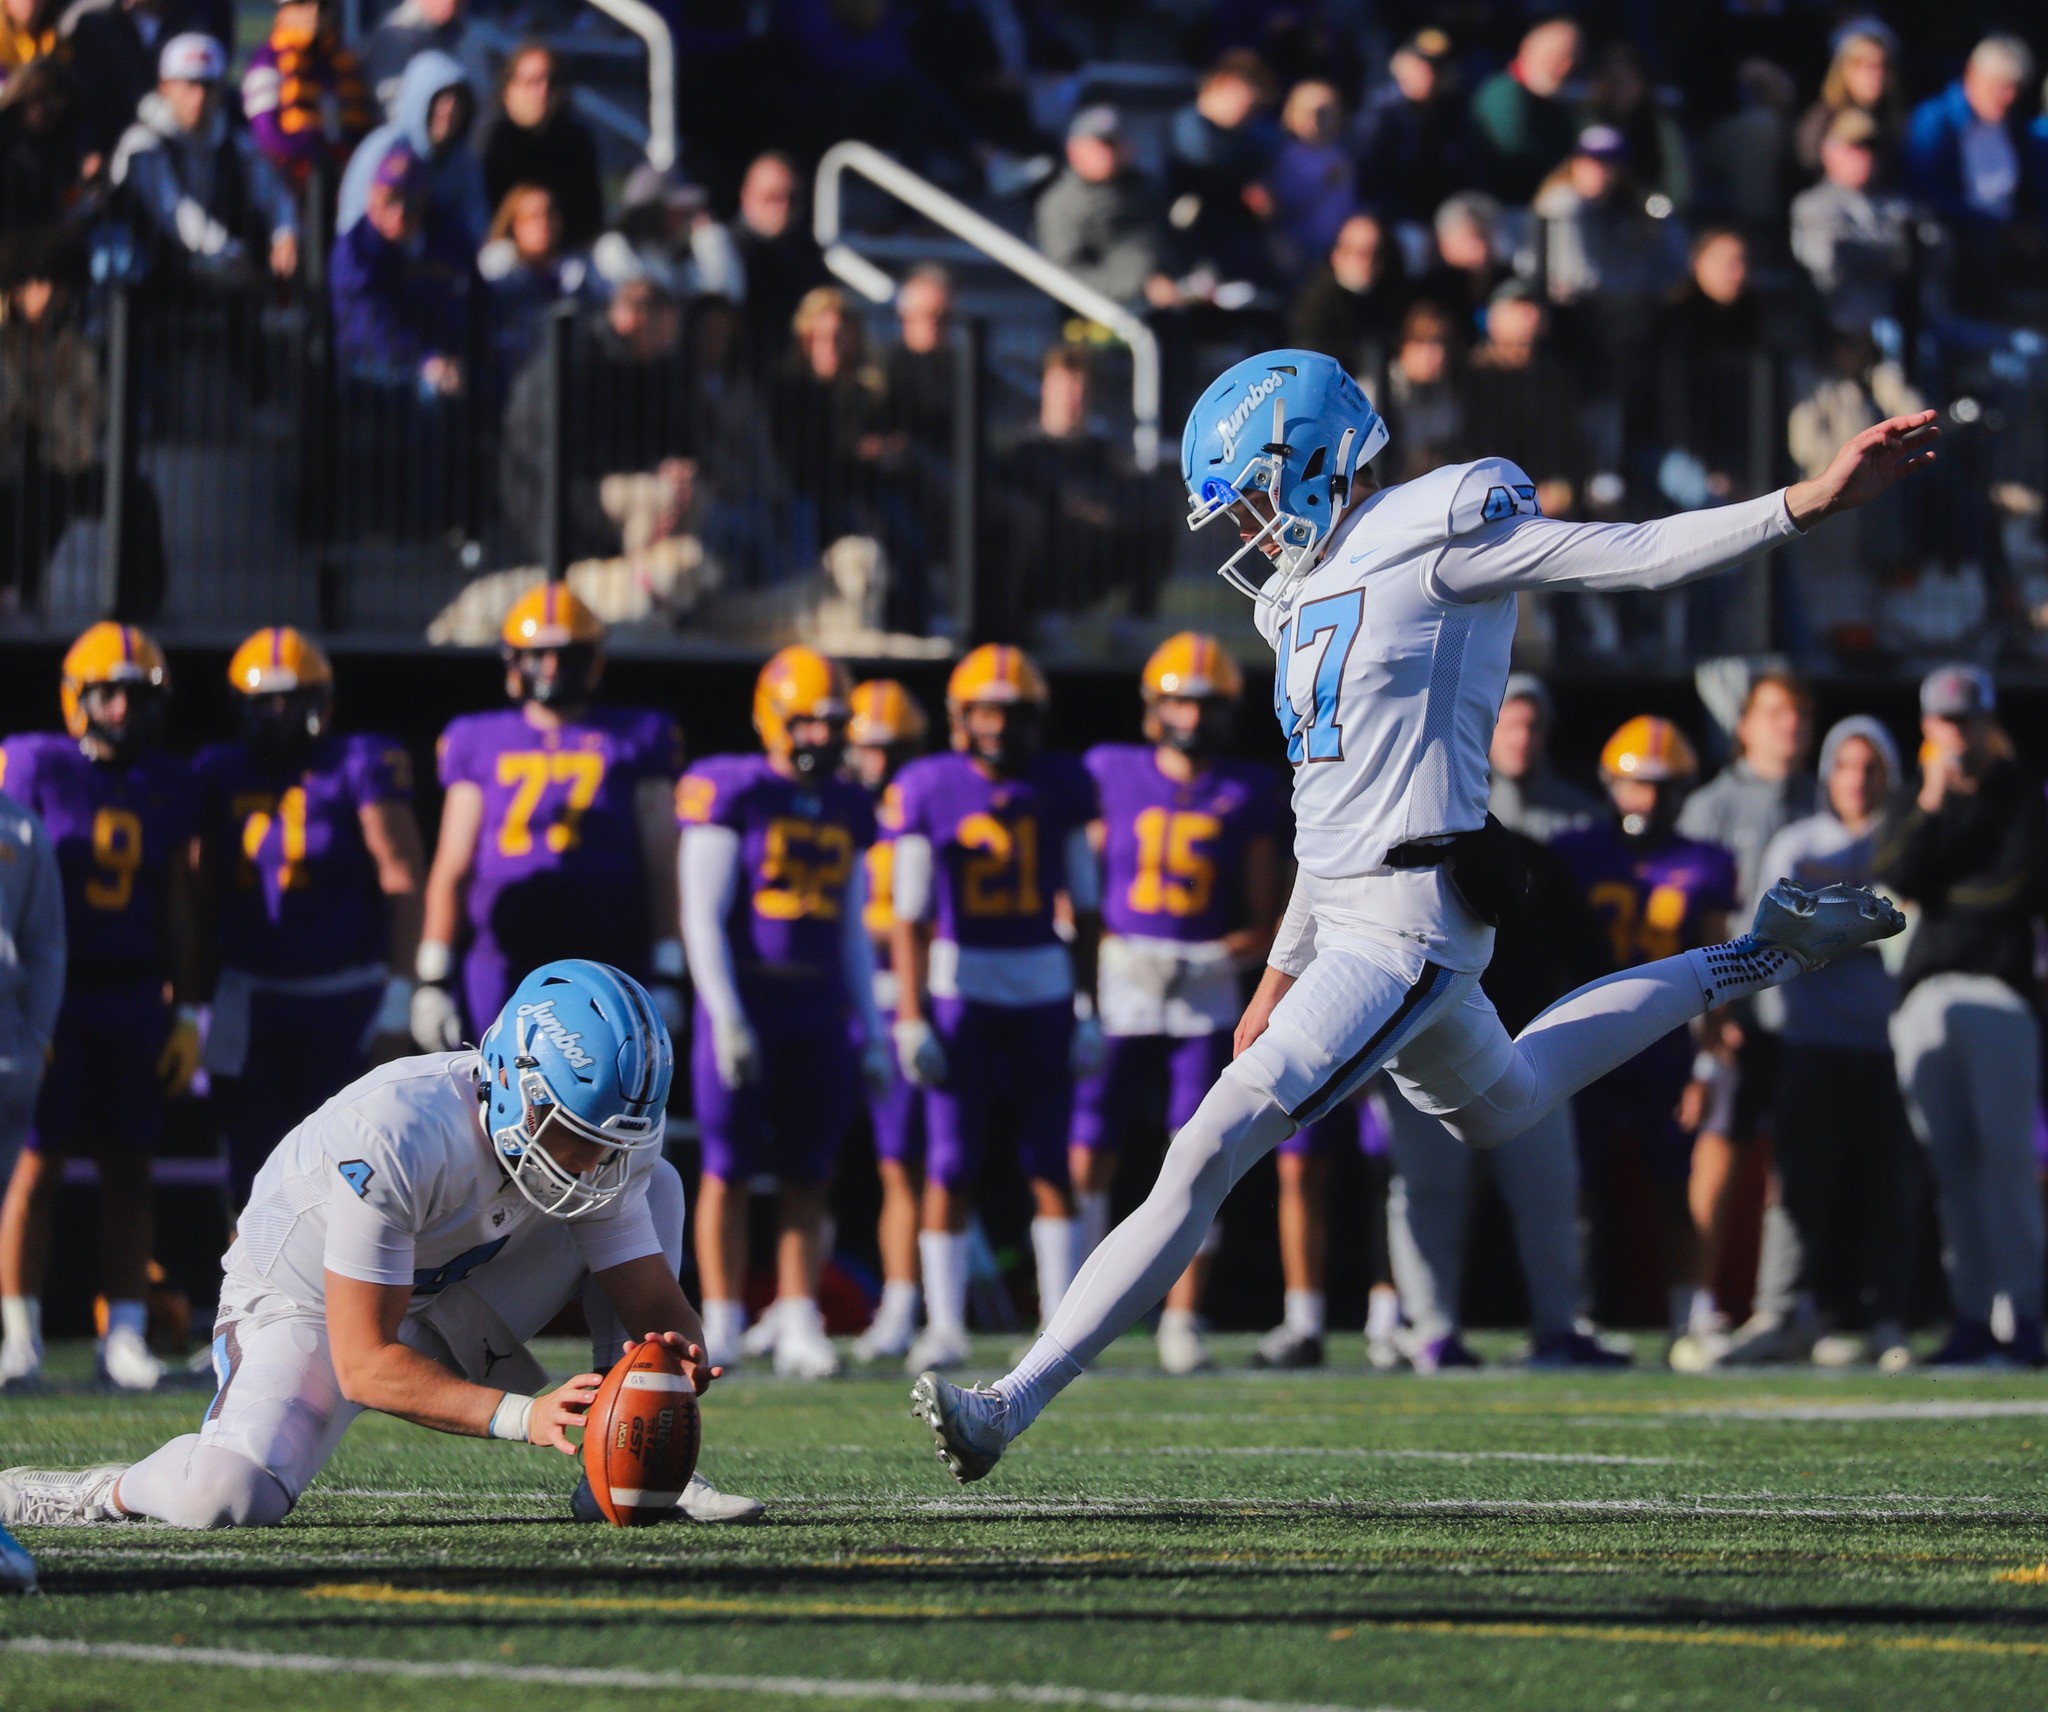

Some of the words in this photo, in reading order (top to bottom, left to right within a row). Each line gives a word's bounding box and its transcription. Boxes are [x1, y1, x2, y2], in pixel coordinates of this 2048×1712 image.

[1216, 370, 1285, 464] Jumbos
[496, 751, 605, 857] 77
[86, 807, 142, 912] 9
[753, 819, 854, 920] 52
[957, 813, 1042, 917] 21
[1127, 805, 1220, 916] 15
[516, 999, 596, 1069] Jumbos
[338, 1159, 375, 1199] 4
[616, 1421, 628, 1449] NCAA
[630, 1416, 645, 1461] GST
